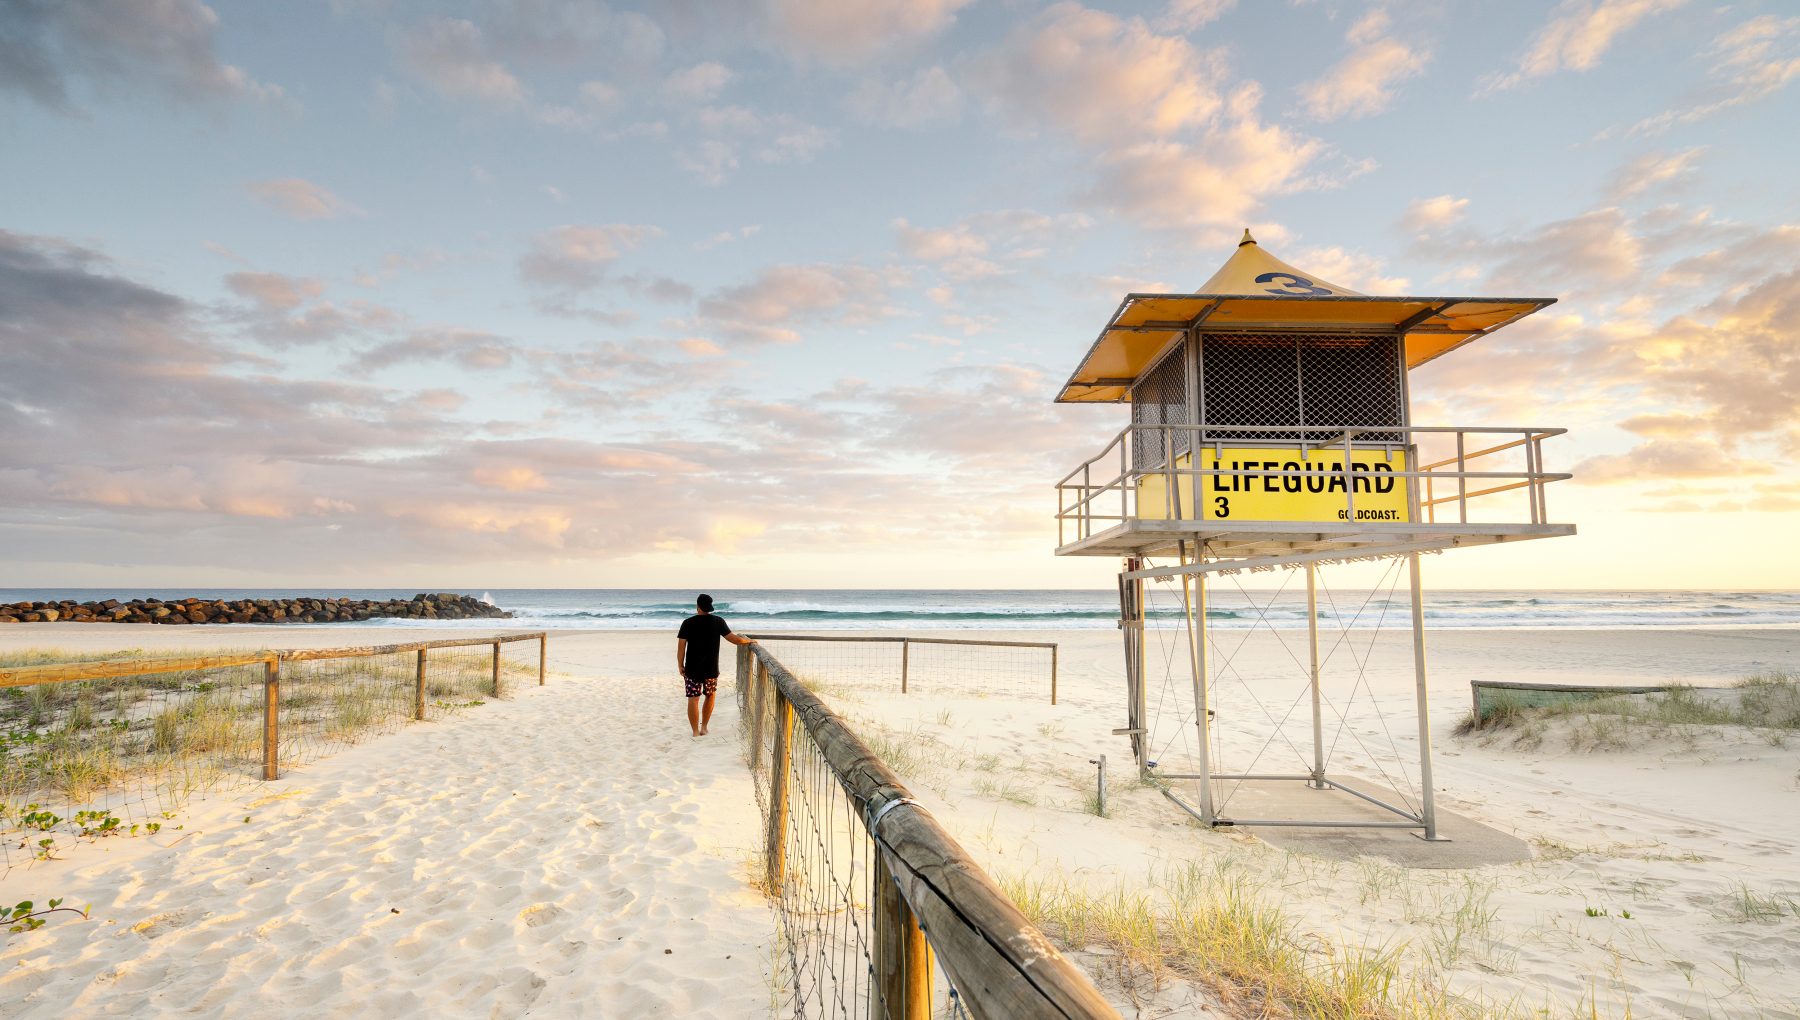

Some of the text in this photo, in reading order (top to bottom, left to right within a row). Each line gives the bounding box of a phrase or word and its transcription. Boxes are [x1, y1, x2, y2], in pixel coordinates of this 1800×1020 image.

[1254, 272, 1333, 296] 3
[1212, 461, 1395, 494] LIFEGUARD
[1214, 496, 1230, 518] 3
[1338, 509, 1400, 520] GODCOAST.
